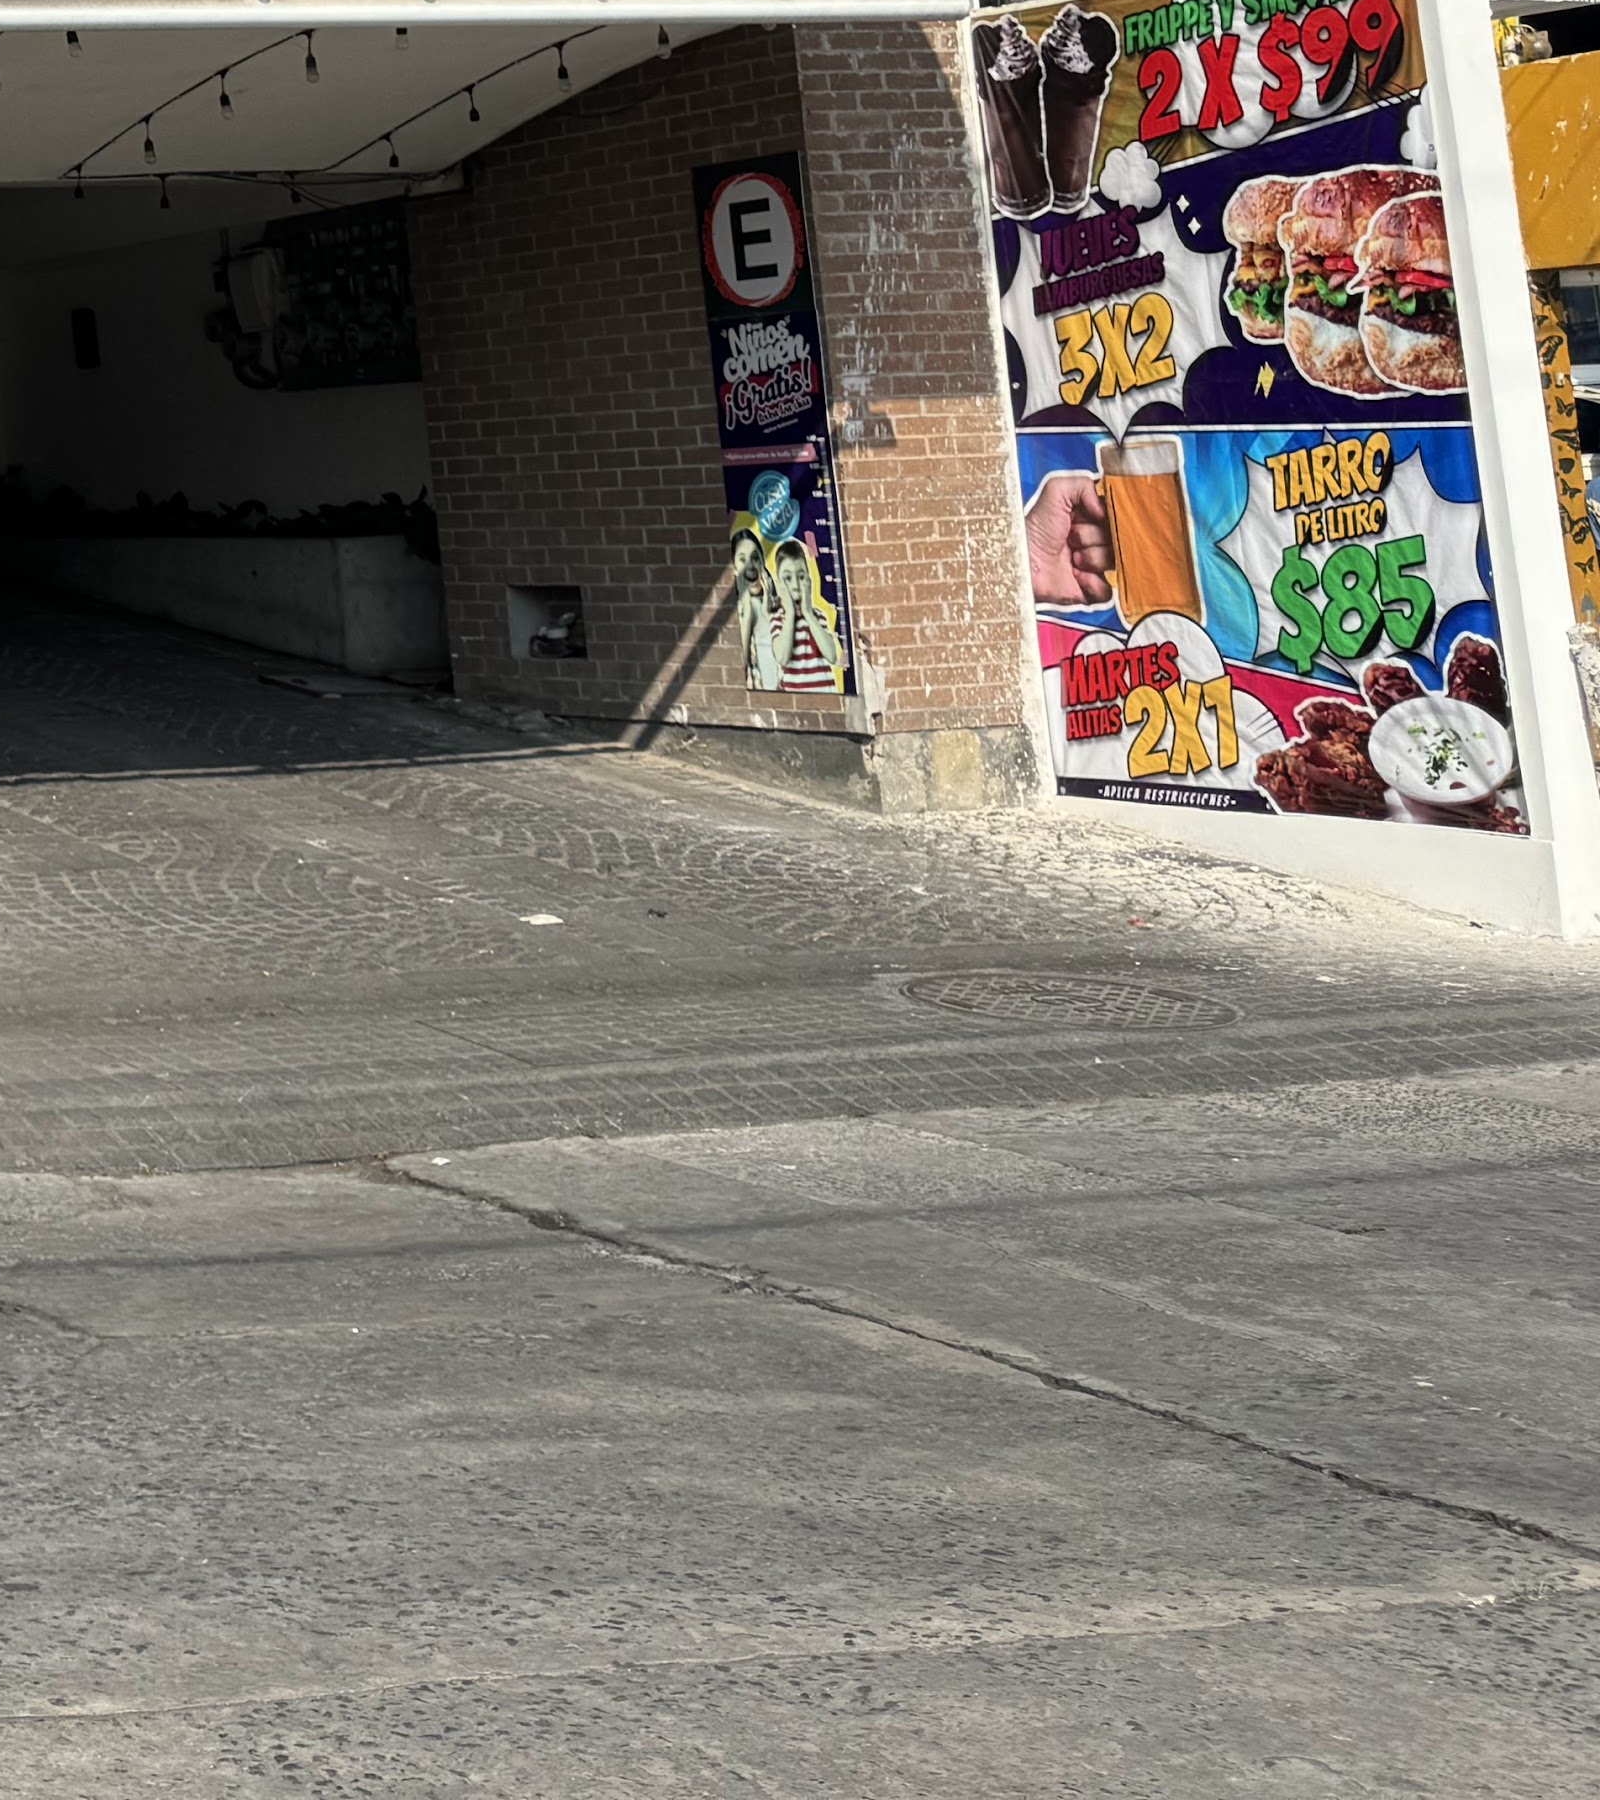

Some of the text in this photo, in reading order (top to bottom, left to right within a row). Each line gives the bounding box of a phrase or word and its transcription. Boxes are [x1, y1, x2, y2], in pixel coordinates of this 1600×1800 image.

[1137, 47, 1182, 143] 2
[1197, 33, 1244, 131] X
[729, 198, 779, 281] E
[723, 334, 810, 383] comen
[1055, 292, 1176, 406] 3X2
[1265, 431, 1394, 512] TARRO
[1295, 497, 1388, 545] DE LITRO
[1270, 534, 1436, 675] $85
[1061, 641, 1181, 708] MARTES
[1067, 675, 1239, 778] ALITAS 2X1
